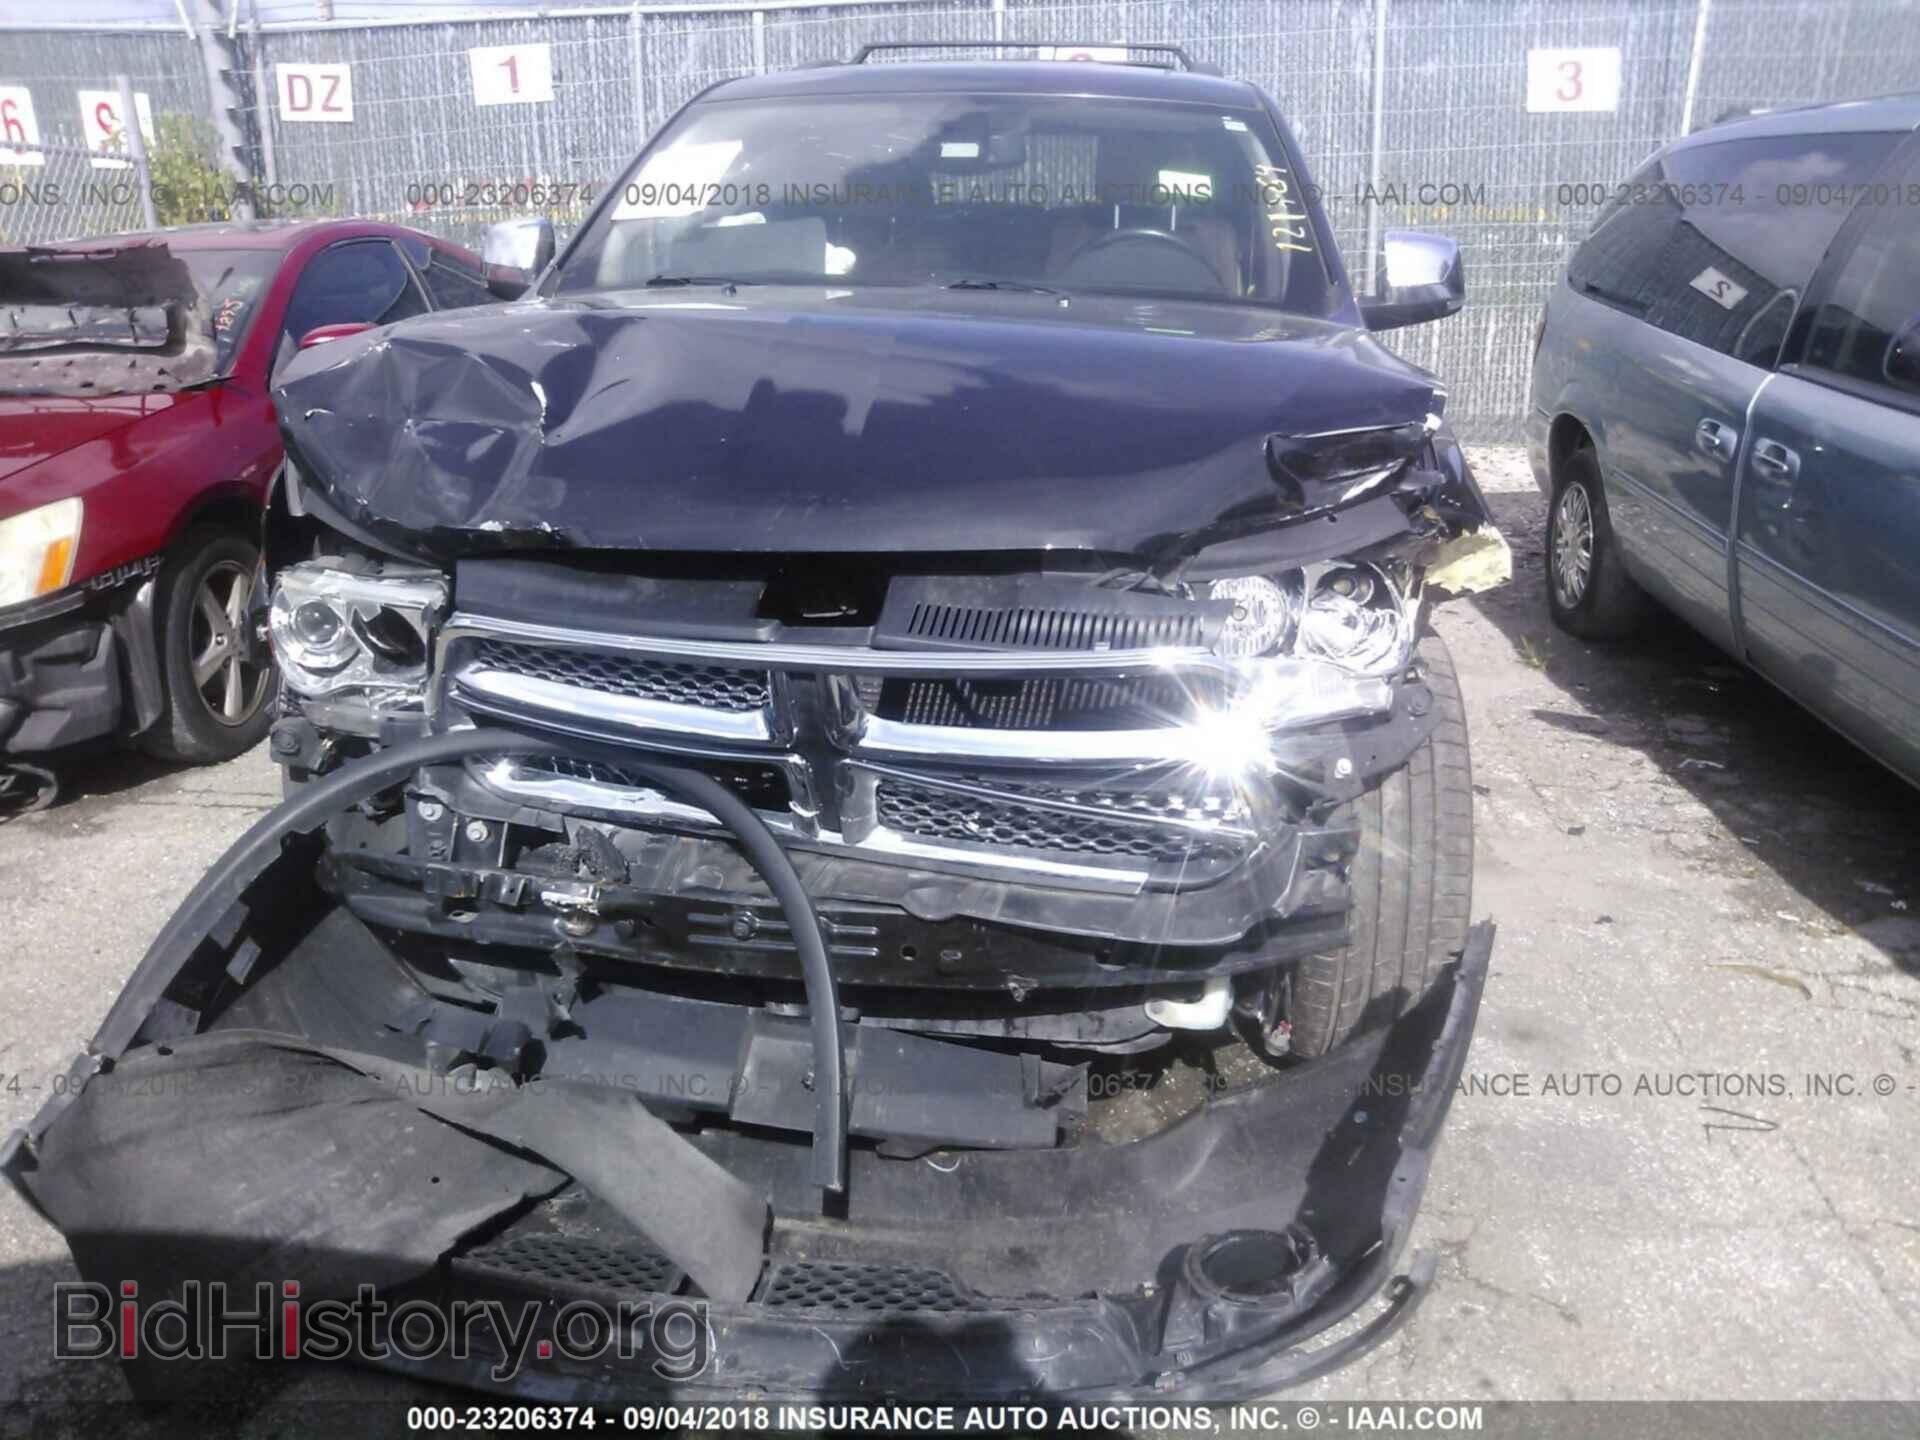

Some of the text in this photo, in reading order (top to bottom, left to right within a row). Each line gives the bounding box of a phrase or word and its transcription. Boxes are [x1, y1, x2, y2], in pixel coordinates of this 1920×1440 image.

[286, 74, 343, 113] DZ
[497, 55, 520, 94] 1
[1556, 61, 1583, 102] 3
